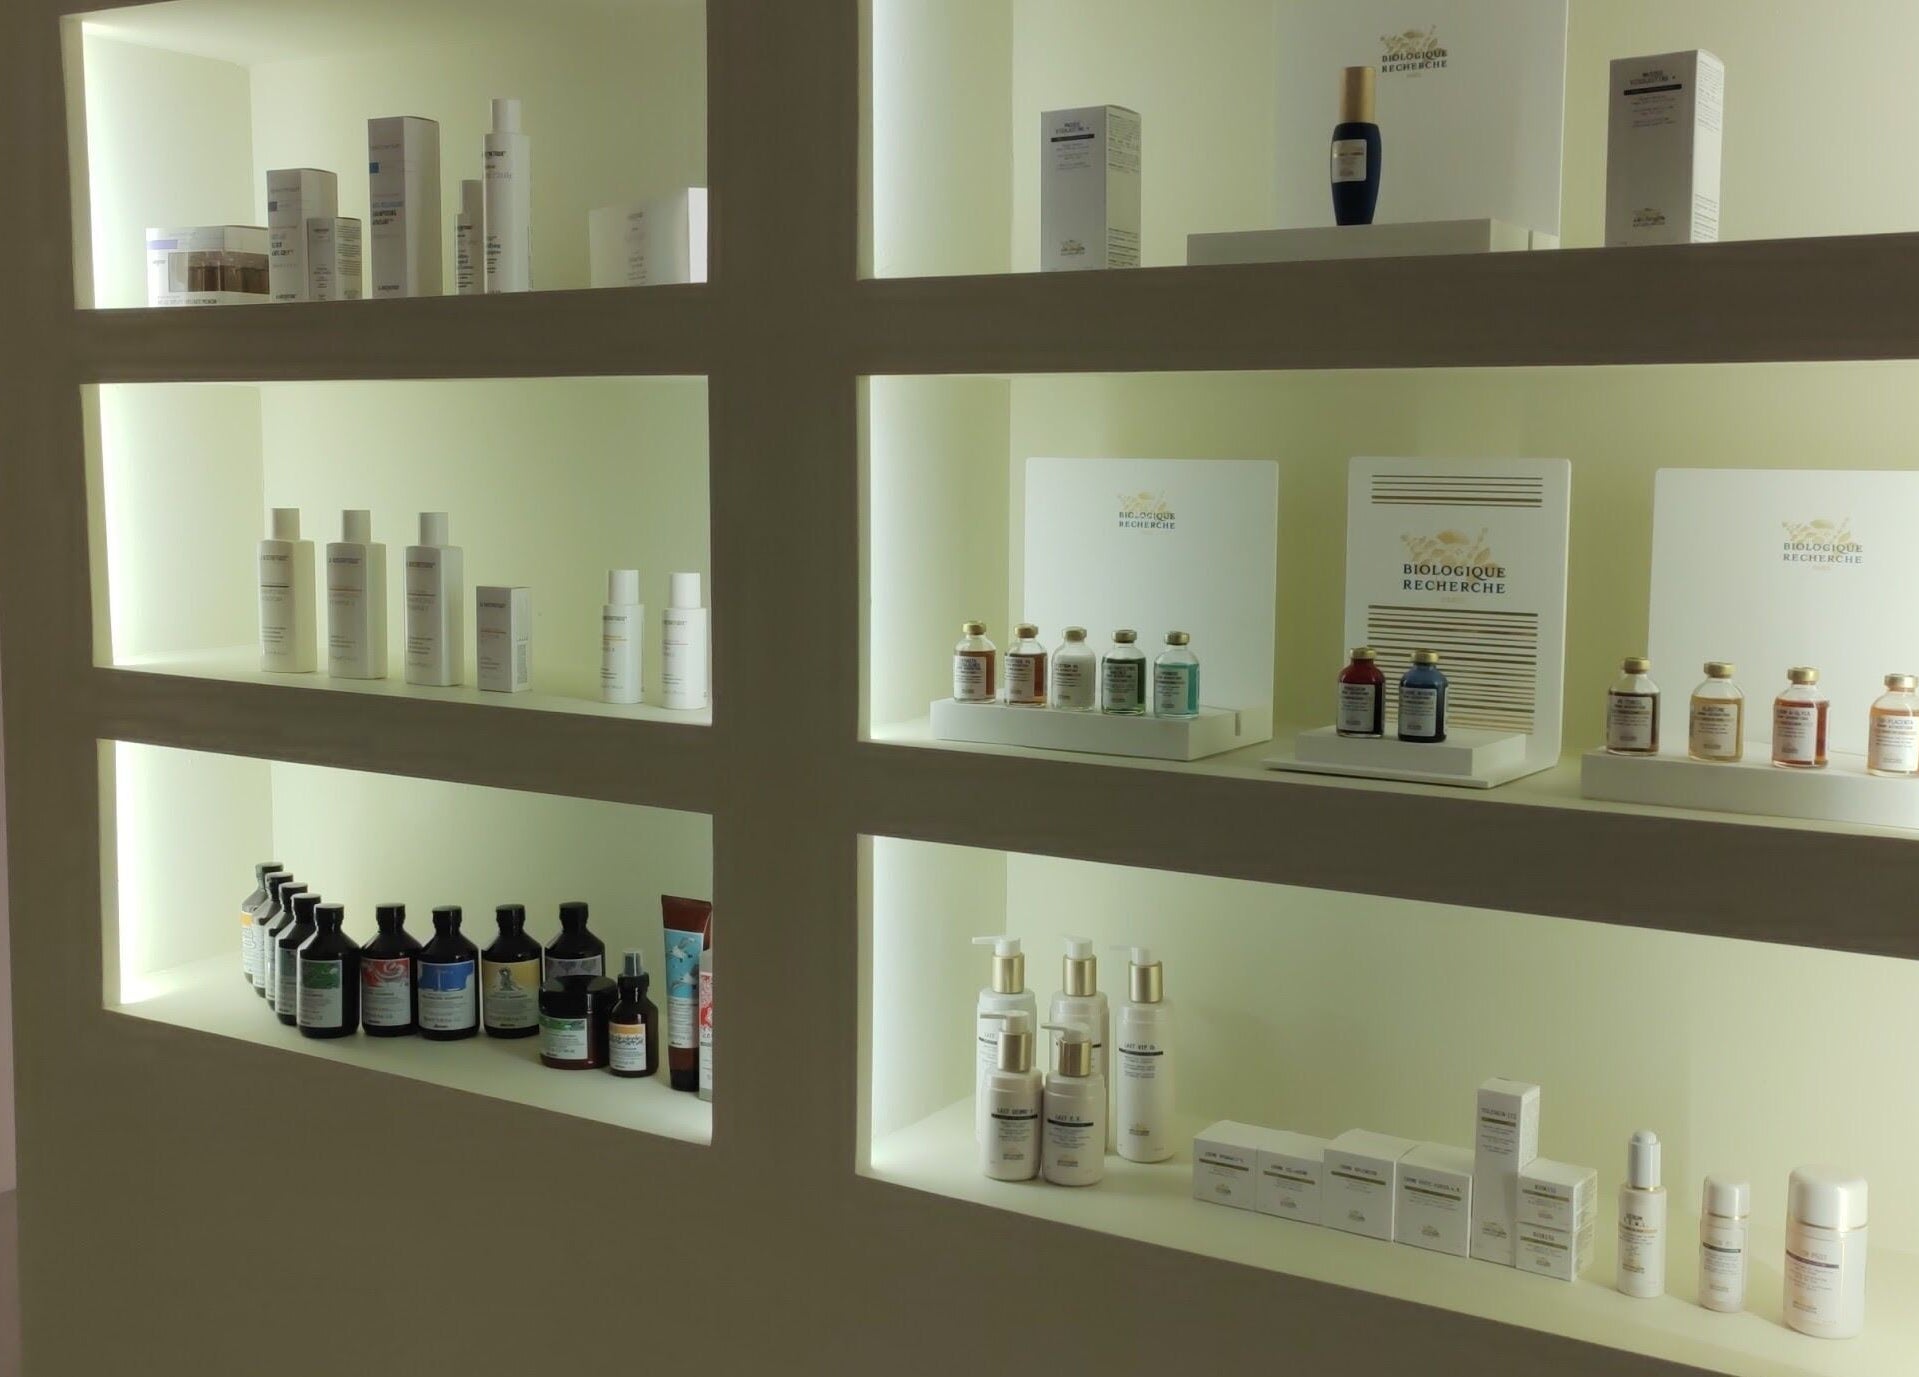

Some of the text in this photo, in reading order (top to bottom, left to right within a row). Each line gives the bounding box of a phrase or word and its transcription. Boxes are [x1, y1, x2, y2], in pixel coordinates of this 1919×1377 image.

[1381, 48, 1448, 63] BIOLOGIQUE
[1381, 60, 1448, 73] RECHERCHE
[1118, 511, 1176, 522] BIOLOGIQUE
[1118, 520, 1176, 530] RECHERCHE
[1783, 542, 1863, 554] BIOLOGIQUE
[1783, 553, 1863, 564] RECHERCHE
[1403, 563, 1507, 581] BIOLOGIQUE
[1403, 579, 1507, 594] RECHERCHE
